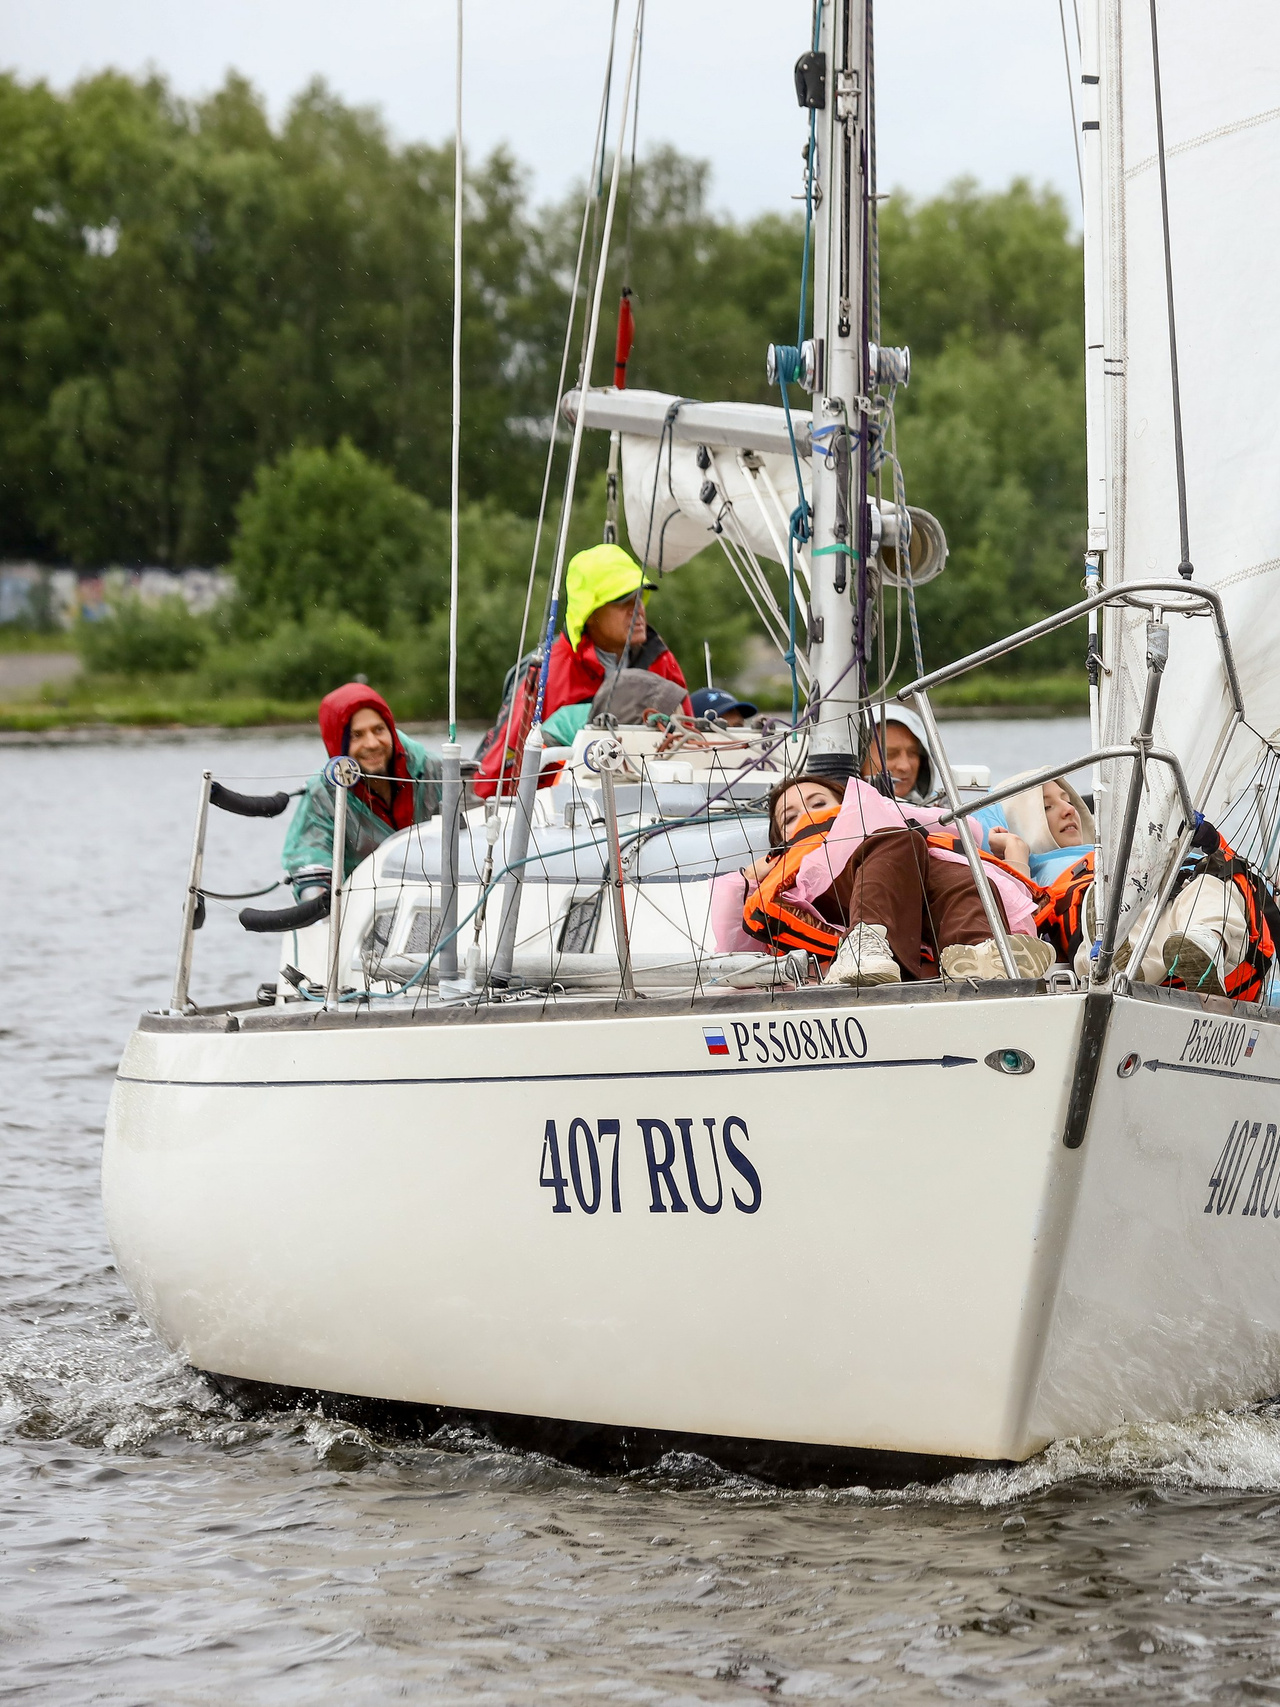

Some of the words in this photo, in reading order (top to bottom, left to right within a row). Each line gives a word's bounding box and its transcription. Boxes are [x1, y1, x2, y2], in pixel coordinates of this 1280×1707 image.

[539, 1117, 621, 1215] 407
[636, 1115, 762, 1215] RUS
[1203, 1119, 1262, 1215] 407
